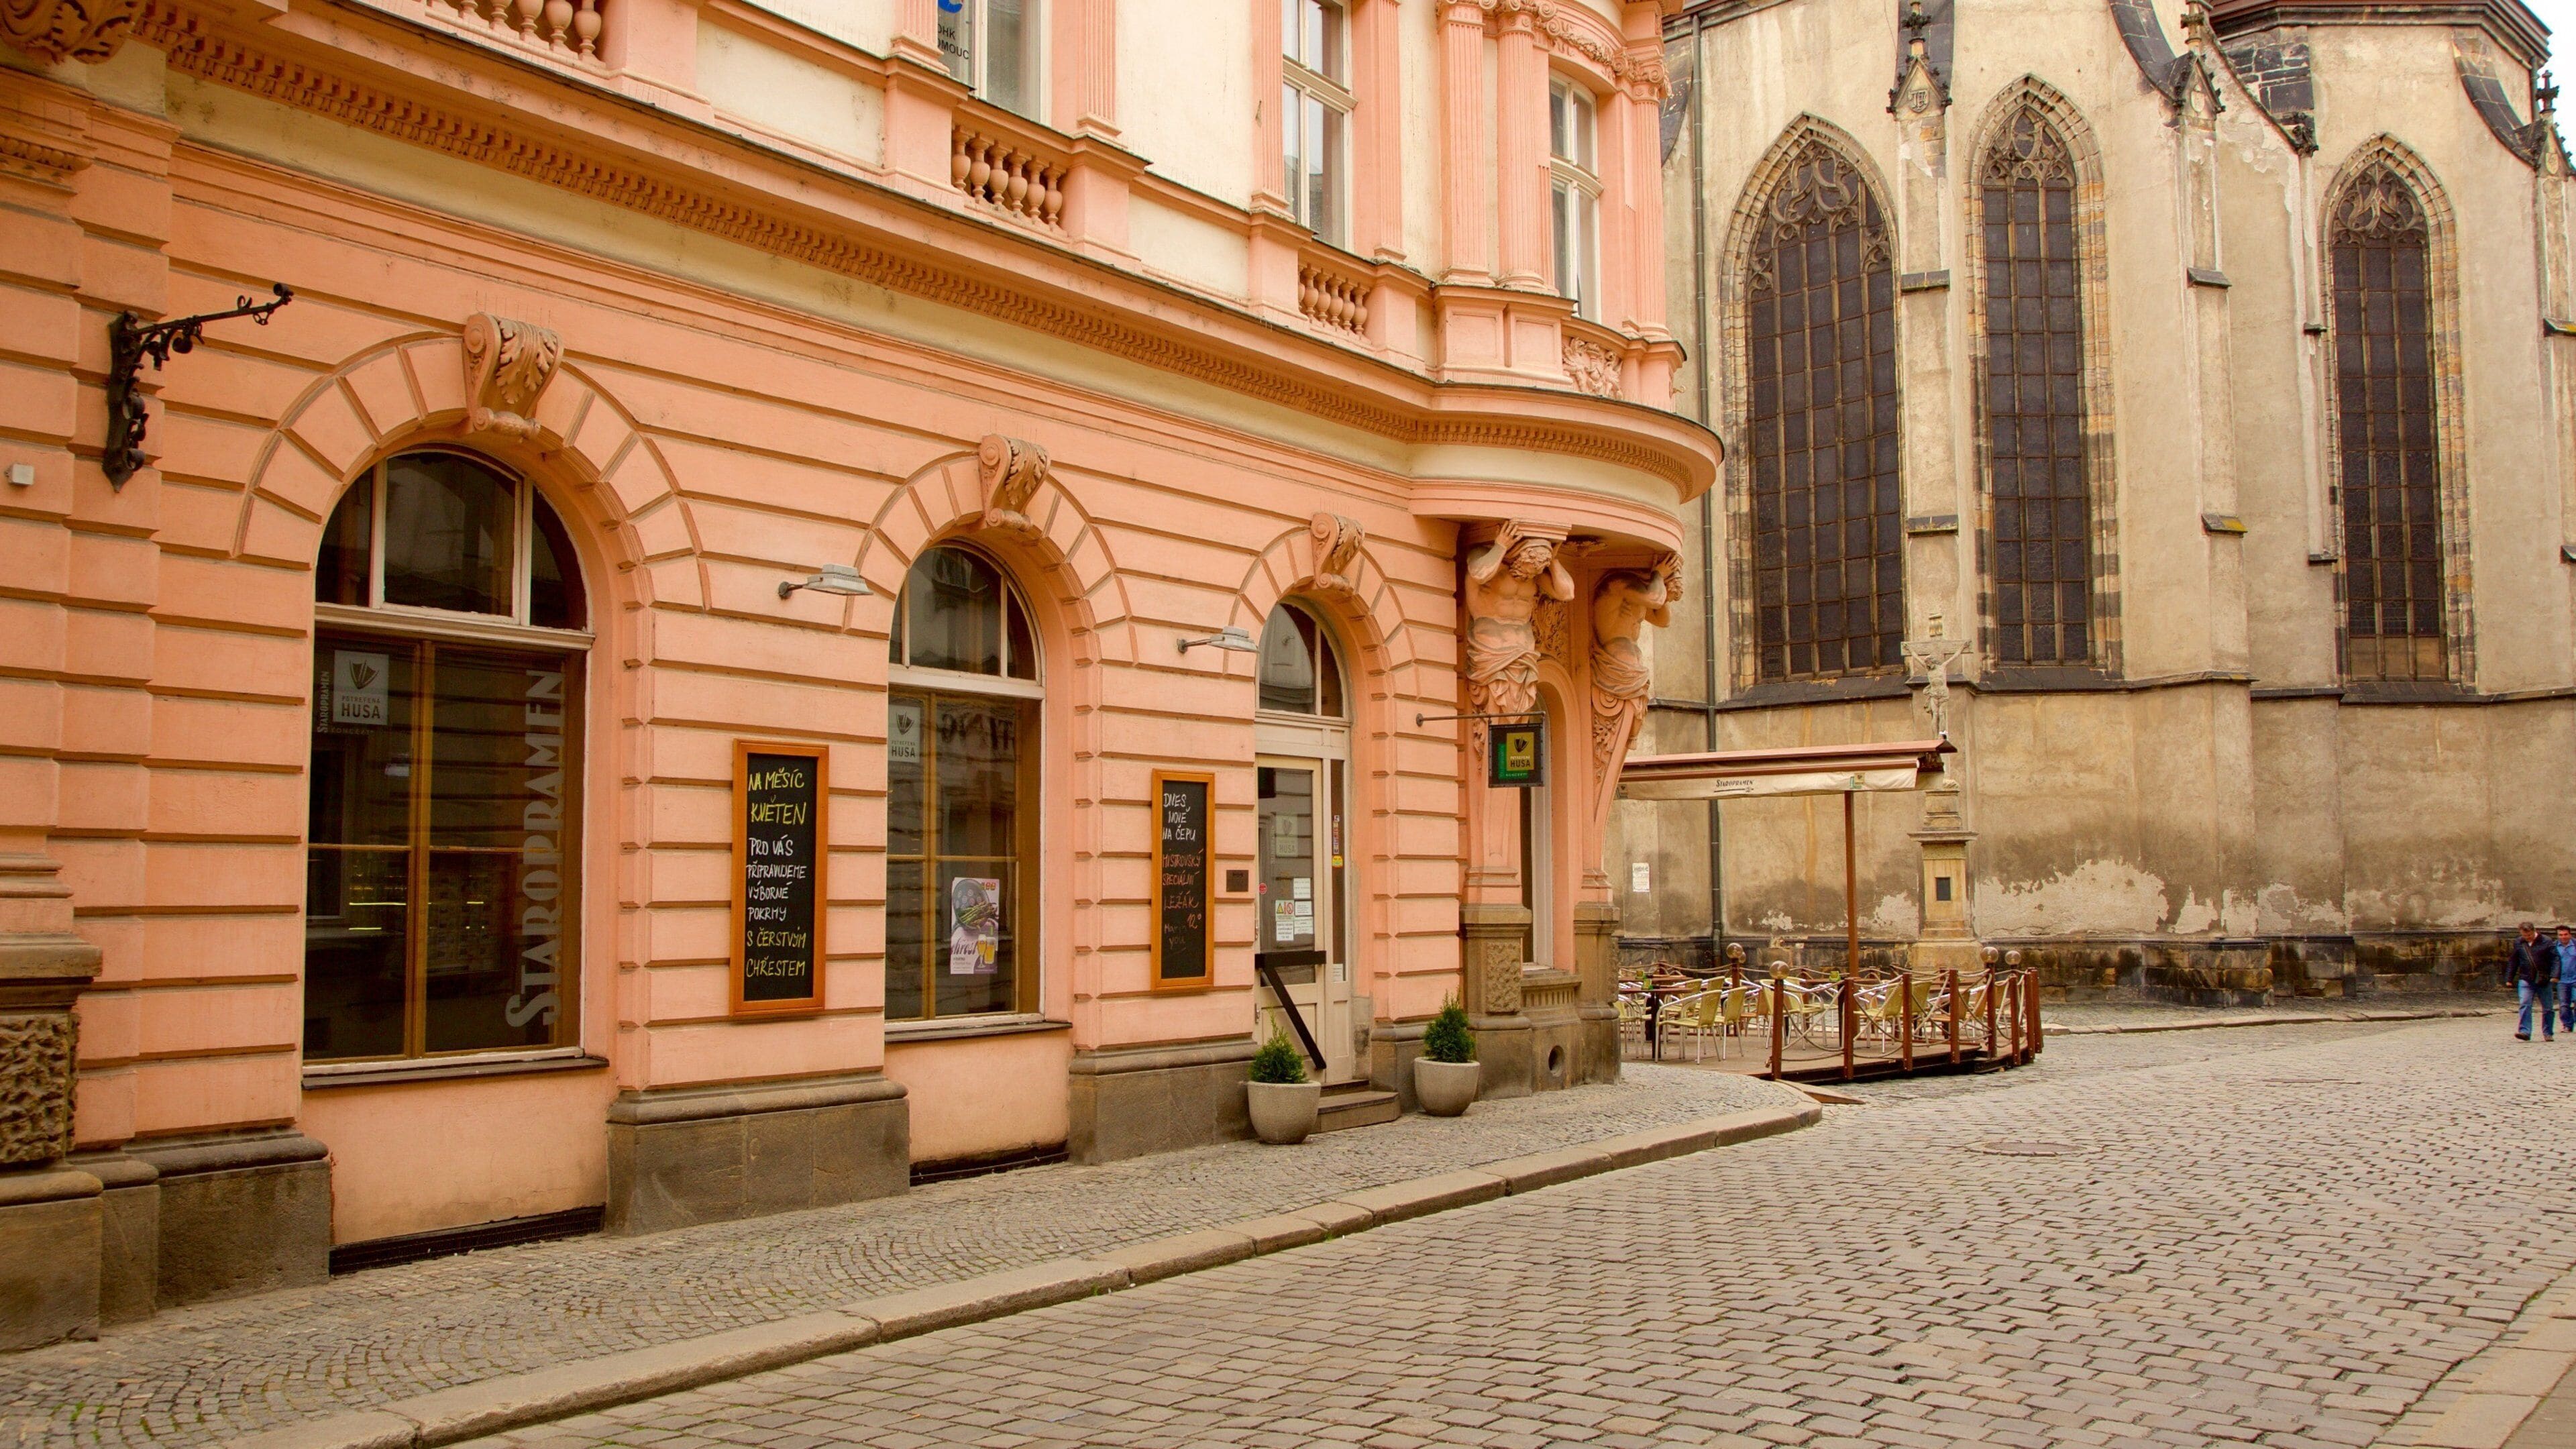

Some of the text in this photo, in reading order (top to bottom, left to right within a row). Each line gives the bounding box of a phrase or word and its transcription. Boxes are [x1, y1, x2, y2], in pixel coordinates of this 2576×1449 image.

[341, 703, 380, 718] HUSA
[892, 746, 916, 757] HUSA
[1510, 759, 1530, 768] HUSA
[749, 767, 804, 792] NA MĚSÍC
[1716, 780, 1754, 788] STAROPRAMEN
[1163, 793, 1187, 808] DNES
[751, 795, 806, 825] KVĚTEN
[1162, 827, 1172, 841] NA
[506, 670, 564, 1028] STAROPRAMEN
[749, 835, 794, 856] PRO VÁS
[748, 881, 792, 900] VÝBORNÉ
[748, 907, 787, 922] POKRMY
[747, 930, 753, 947] S
[746, 956, 805, 977] CHŘESTEM
